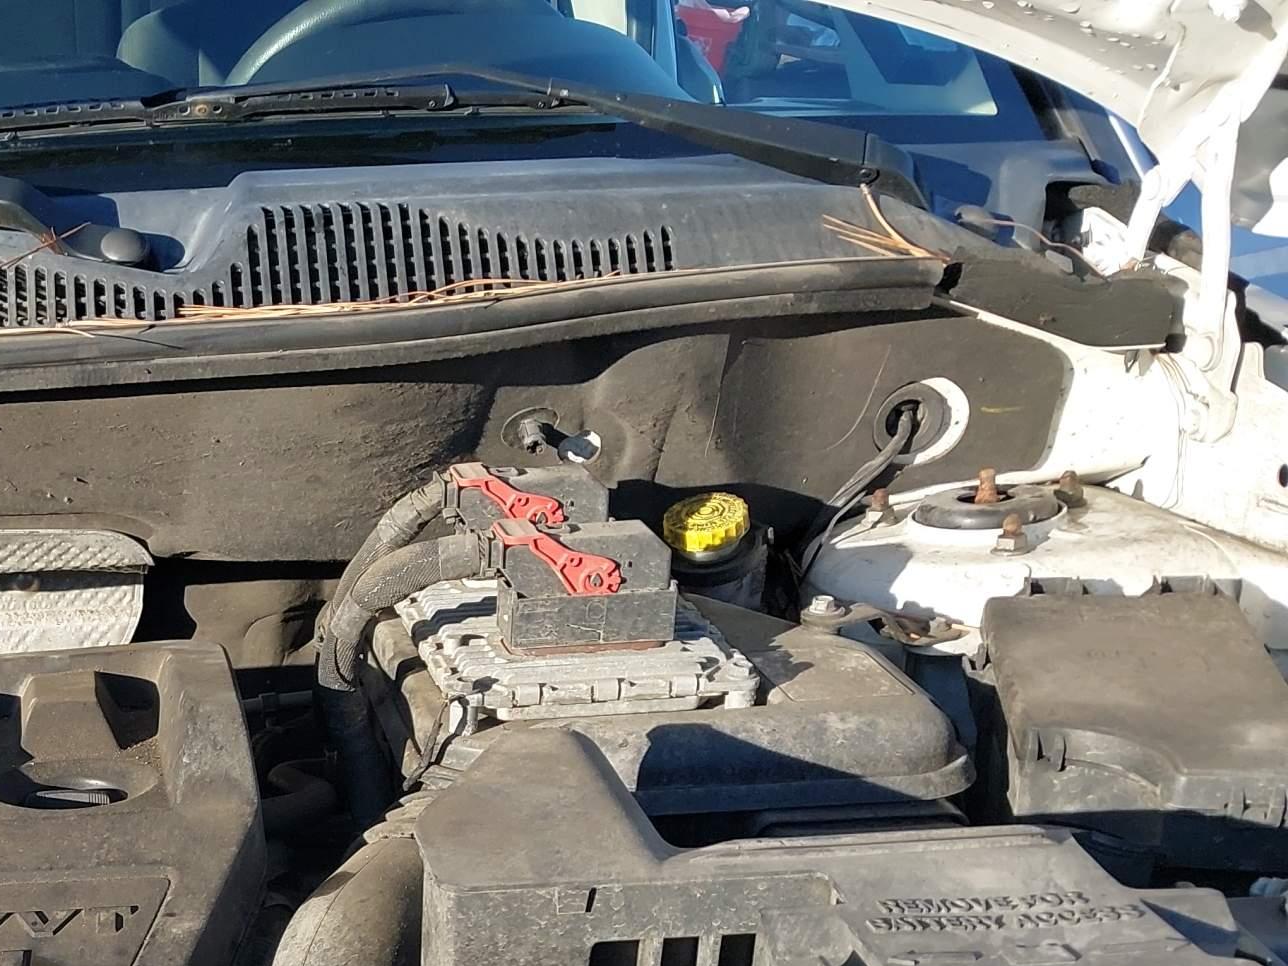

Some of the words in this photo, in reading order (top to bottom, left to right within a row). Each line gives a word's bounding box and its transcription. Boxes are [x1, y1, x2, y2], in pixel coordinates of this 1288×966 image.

[876, 896, 1018, 914] REMOVE
[1018, 891, 1090, 909] FOR
[865, 914, 1006, 932] BATTERY
[1015, 904, 1146, 929] ACCESS
